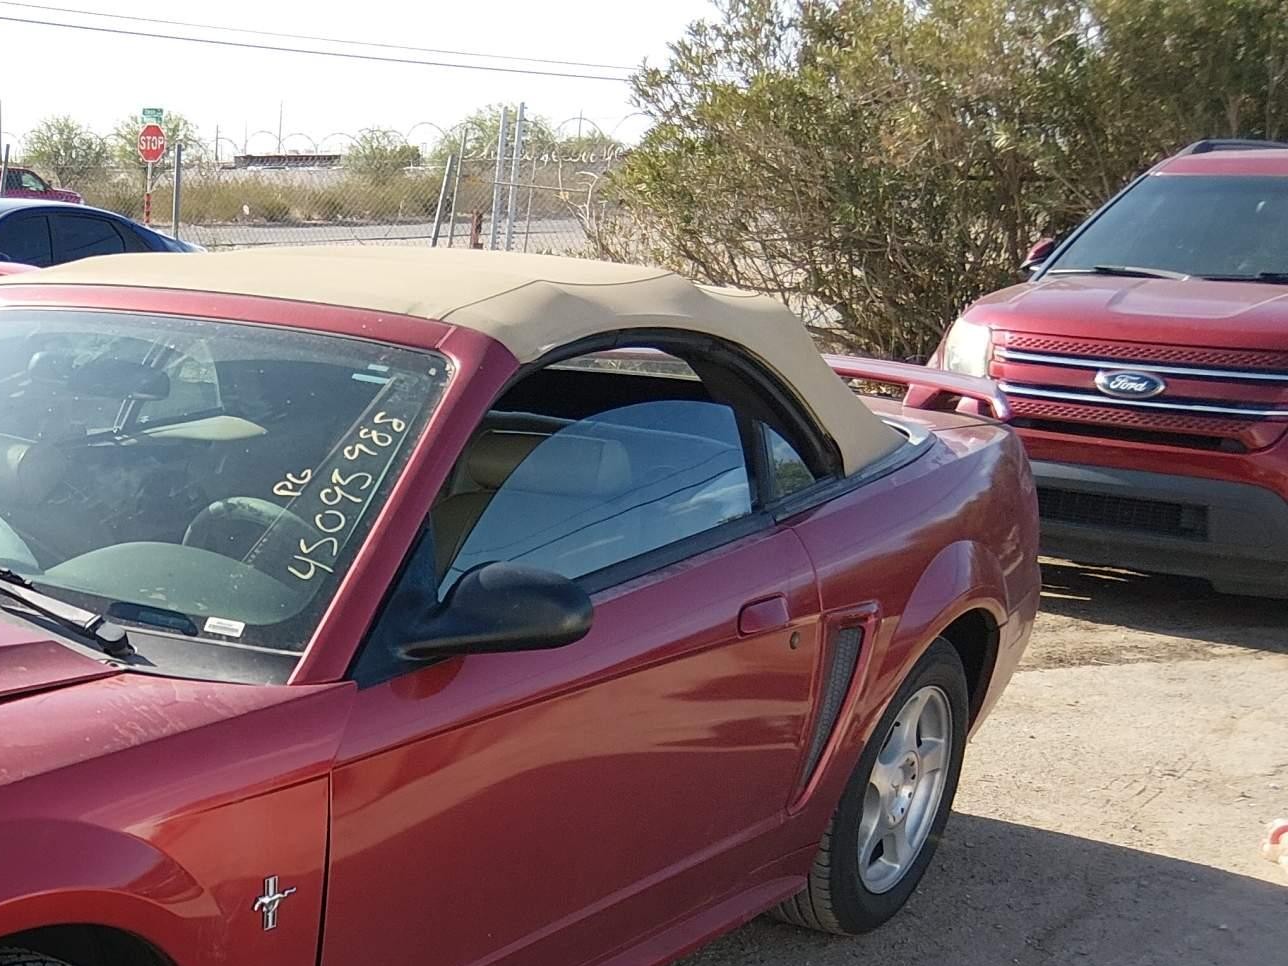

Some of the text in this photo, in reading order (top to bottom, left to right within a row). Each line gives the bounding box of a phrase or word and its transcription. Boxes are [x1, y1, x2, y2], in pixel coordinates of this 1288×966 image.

[139, 135, 164, 150] STOP
[1110, 374, 1149, 392] Ford
[287, 411, 406, 580] 45095988
